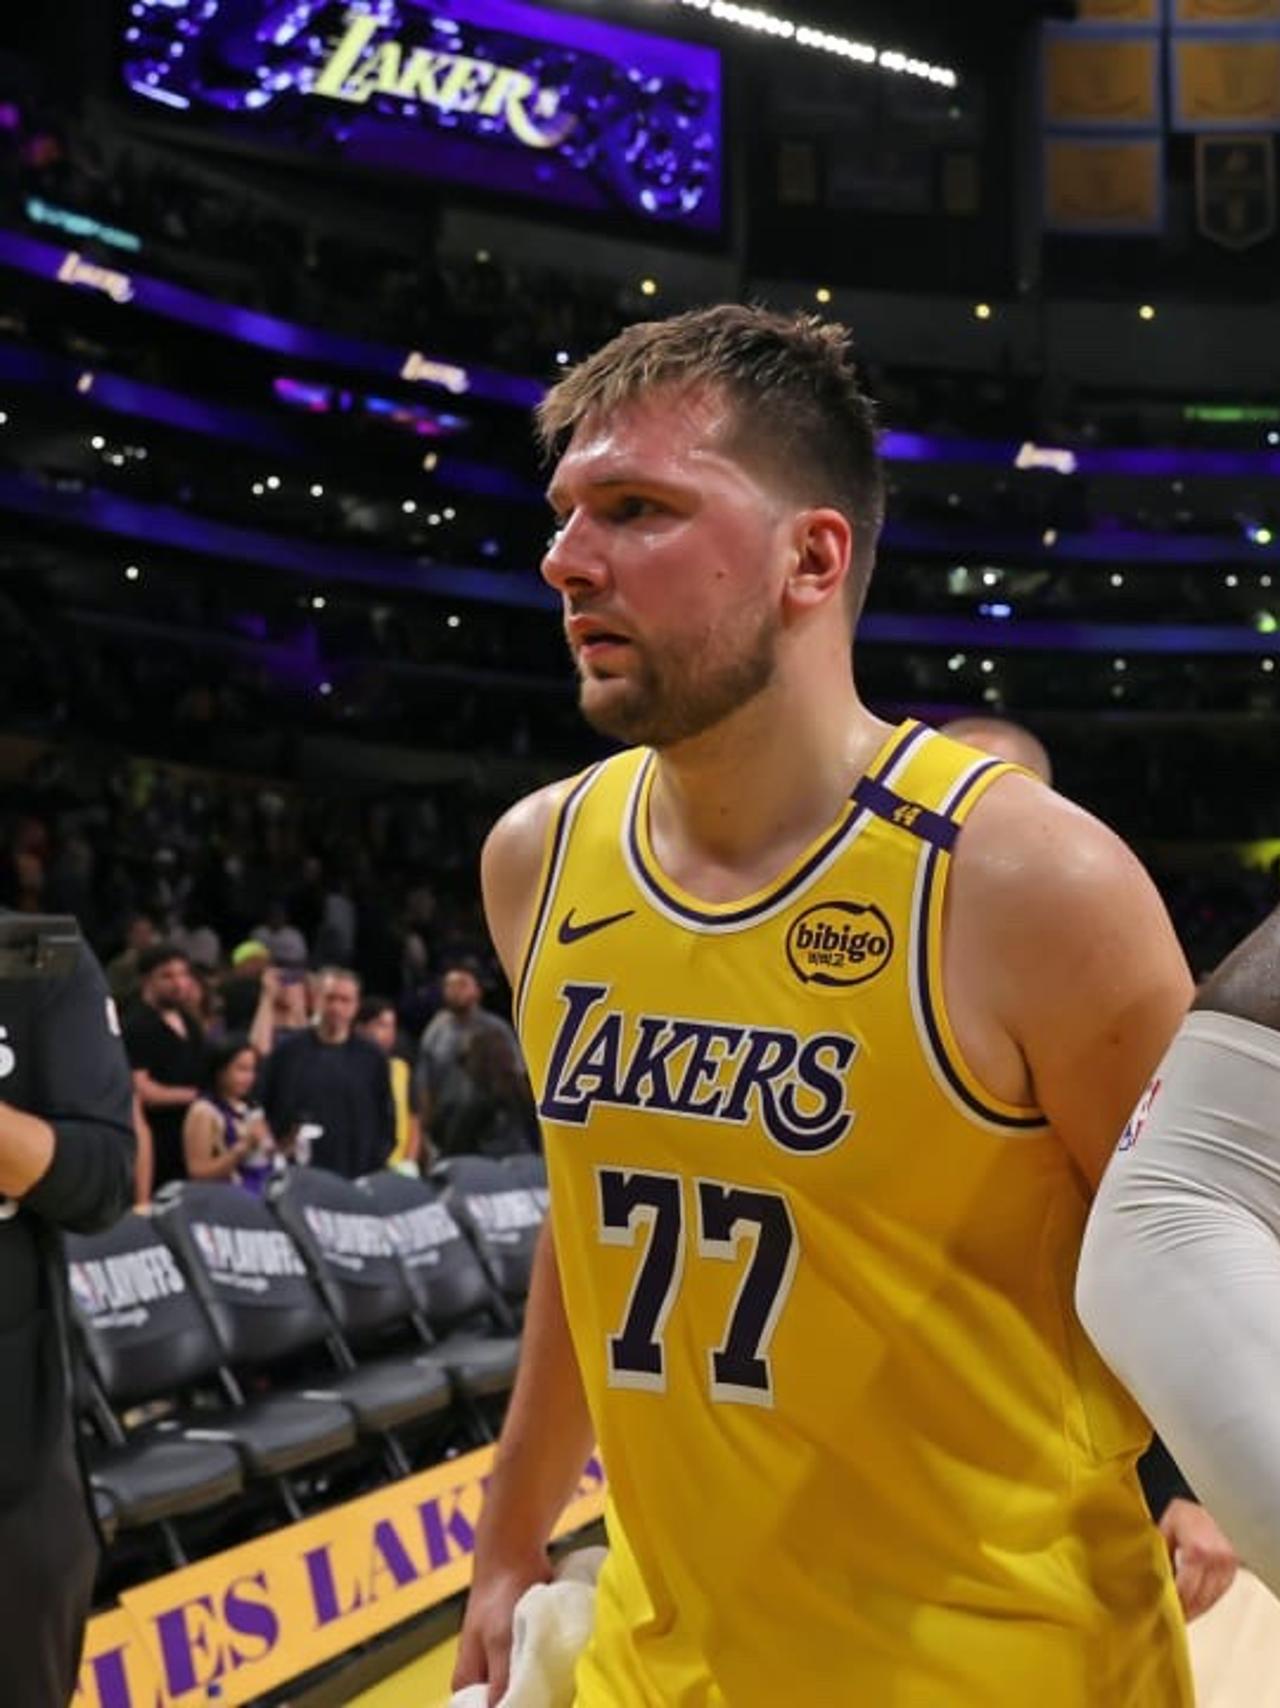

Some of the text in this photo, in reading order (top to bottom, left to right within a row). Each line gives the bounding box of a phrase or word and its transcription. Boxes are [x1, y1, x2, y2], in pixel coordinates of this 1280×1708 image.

[796, 922, 886, 964] bibigo
[537, 981, 860, 1156] LAKERS
[595, 1165, 800, 1408] 77
[73, 1569, 280, 1708] LES
